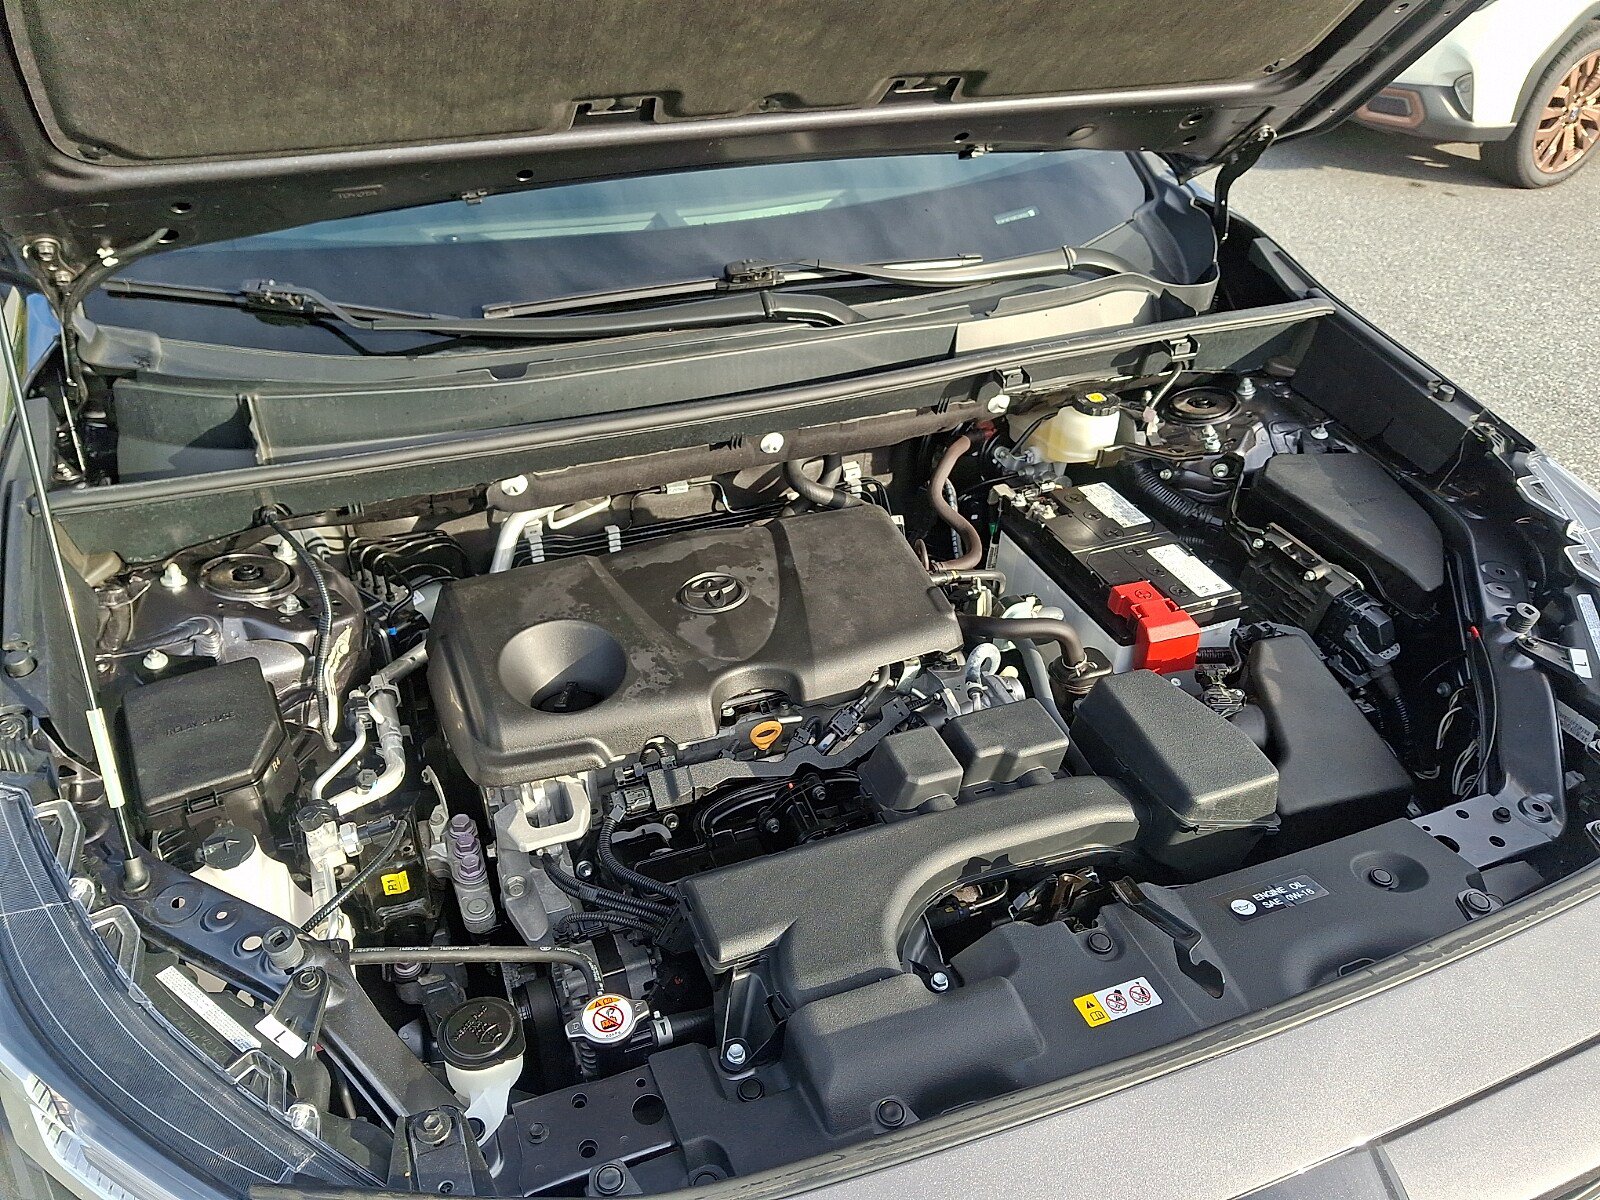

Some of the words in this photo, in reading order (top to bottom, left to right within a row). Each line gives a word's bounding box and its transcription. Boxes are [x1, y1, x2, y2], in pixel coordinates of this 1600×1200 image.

[1252, 886, 1288, 901] ENGINE
[1288, 881, 1307, 890] OIL
[1262, 898, 1284, 909] SAE
[1285, 888, 1315, 901] 0W-16
[273, 1030, 286, 1044] L
